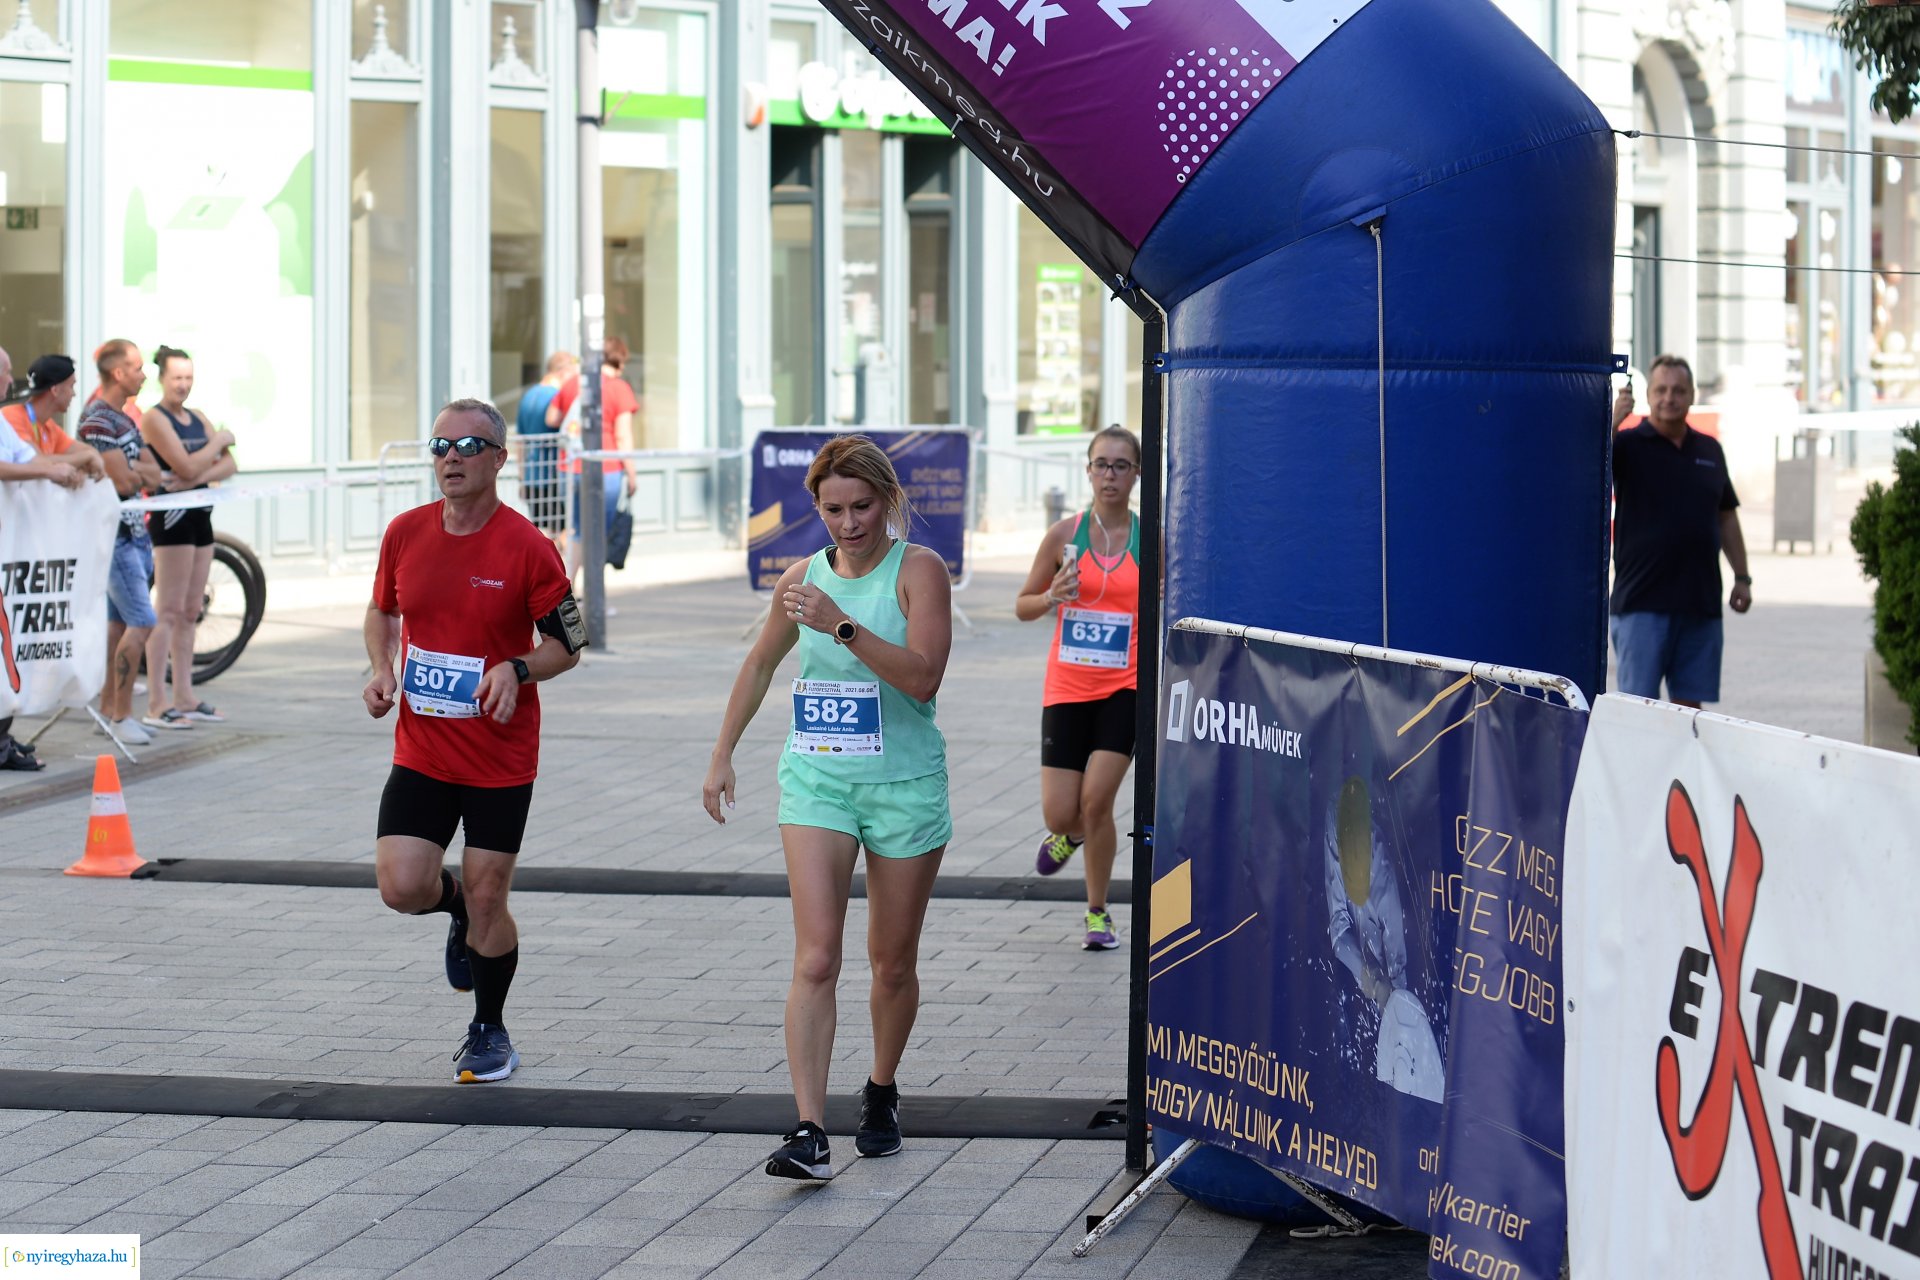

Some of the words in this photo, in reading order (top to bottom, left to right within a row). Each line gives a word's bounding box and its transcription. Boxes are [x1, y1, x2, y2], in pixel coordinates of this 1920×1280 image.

[848, 0, 1054, 197] zaikmed.hu
[15, 641, 63, 662] HUNGARY
[1072, 622, 1117, 644] 637
[414, 664, 462, 692] 507
[803, 698, 859, 724] 582
[1516, 840, 1559, 908] MEG,
[1507, 900, 1560, 962] VAGY
[1147, 1023, 1171, 1062] MI
[1177, 1030, 1314, 1114] MEGGYŐZÜNK,
[1146, 1075, 1203, 1123] HOGY
[1203, 1089, 1283, 1154] NÁLUNK
[1287, 1122, 1301, 1160] A
[1307, 1128, 1378, 1191] HELYED
